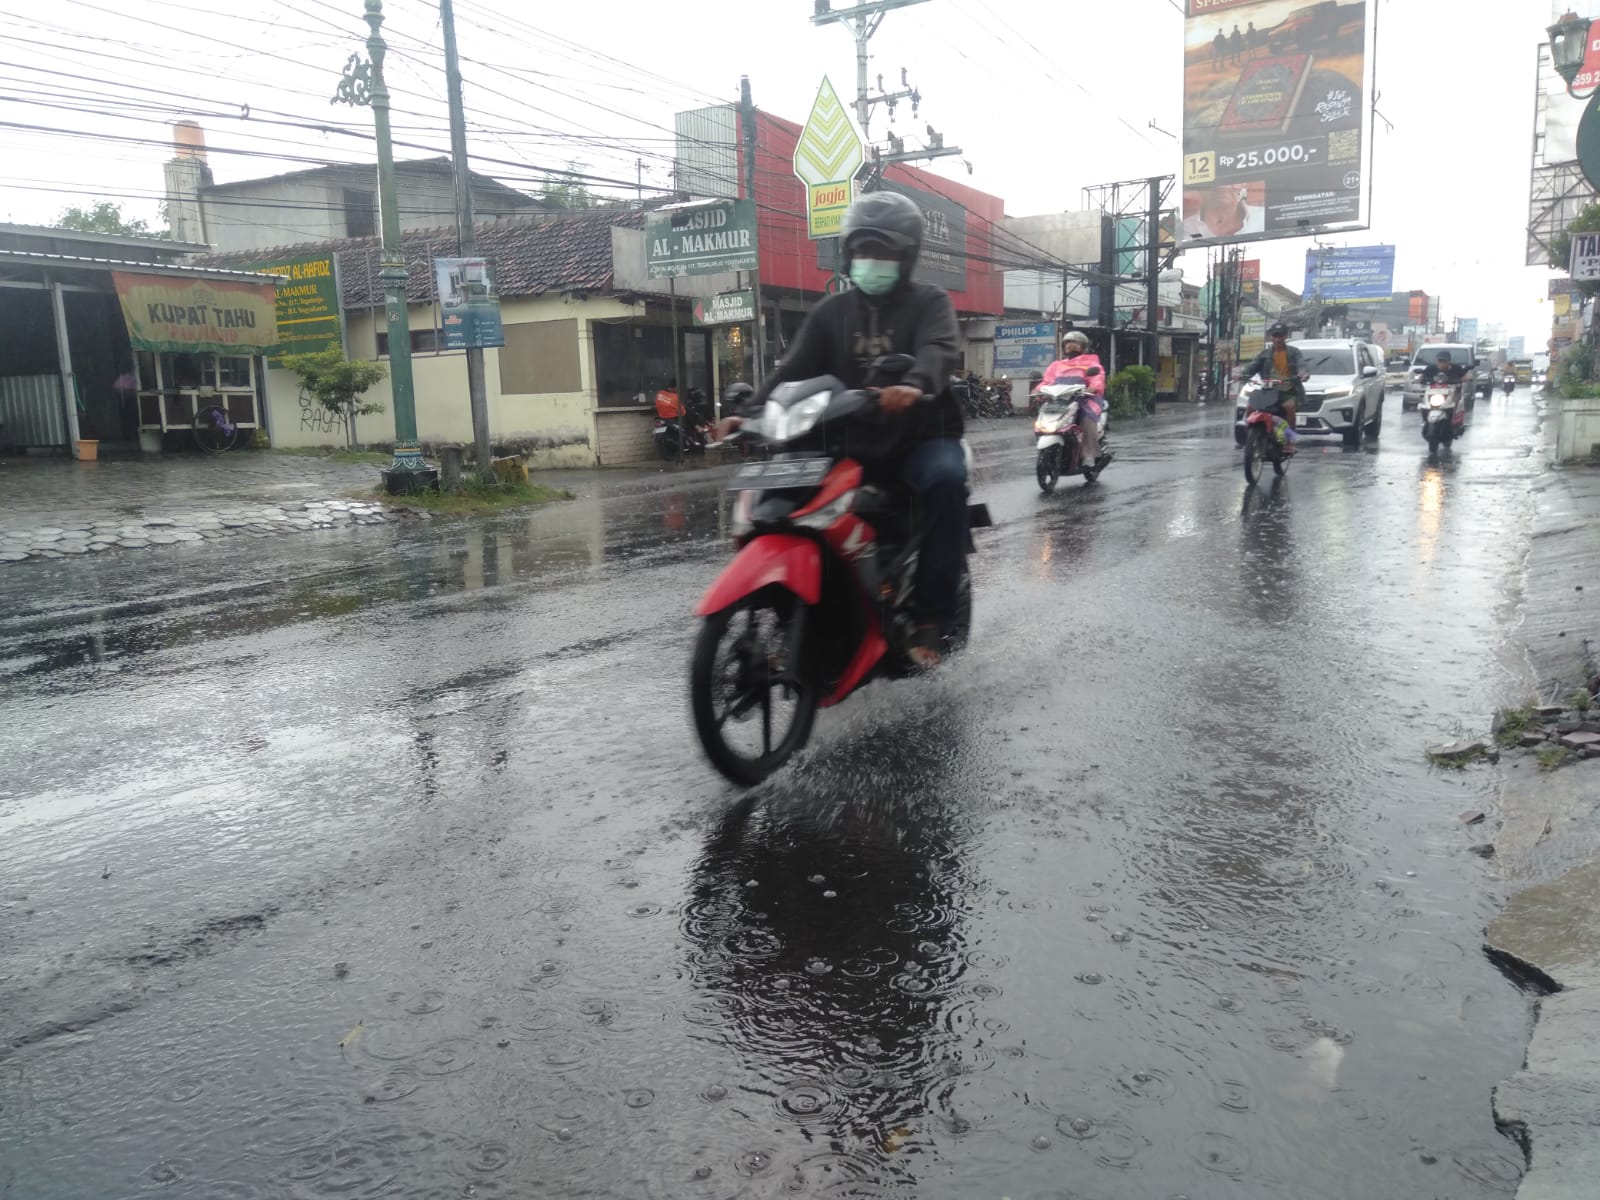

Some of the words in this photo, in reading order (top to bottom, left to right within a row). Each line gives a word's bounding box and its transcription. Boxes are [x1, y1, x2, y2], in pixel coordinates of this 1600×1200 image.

[1189, 156, 1209, 175] 12
[1219, 155, 1234, 168] Rp
[1236, 144, 1317, 169] 25.000,-
[814, 187, 847, 207] jogja
[672, 209, 727, 232] ASJID
[653, 238, 671, 256] AL
[682, 229, 751, 254] MAKMUR
[1579, 235, 1600, 257] TA
[292, 260, 331, 280] AL-HAFIDZ
[712, 296, 743, 309] MASJID
[146, 303, 208, 325] KUPAT
[213, 308, 256, 329] TAHU
[703, 307, 753, 322] AL-MAKMUR
[1001, 326, 1037, 337] PHILIPS
